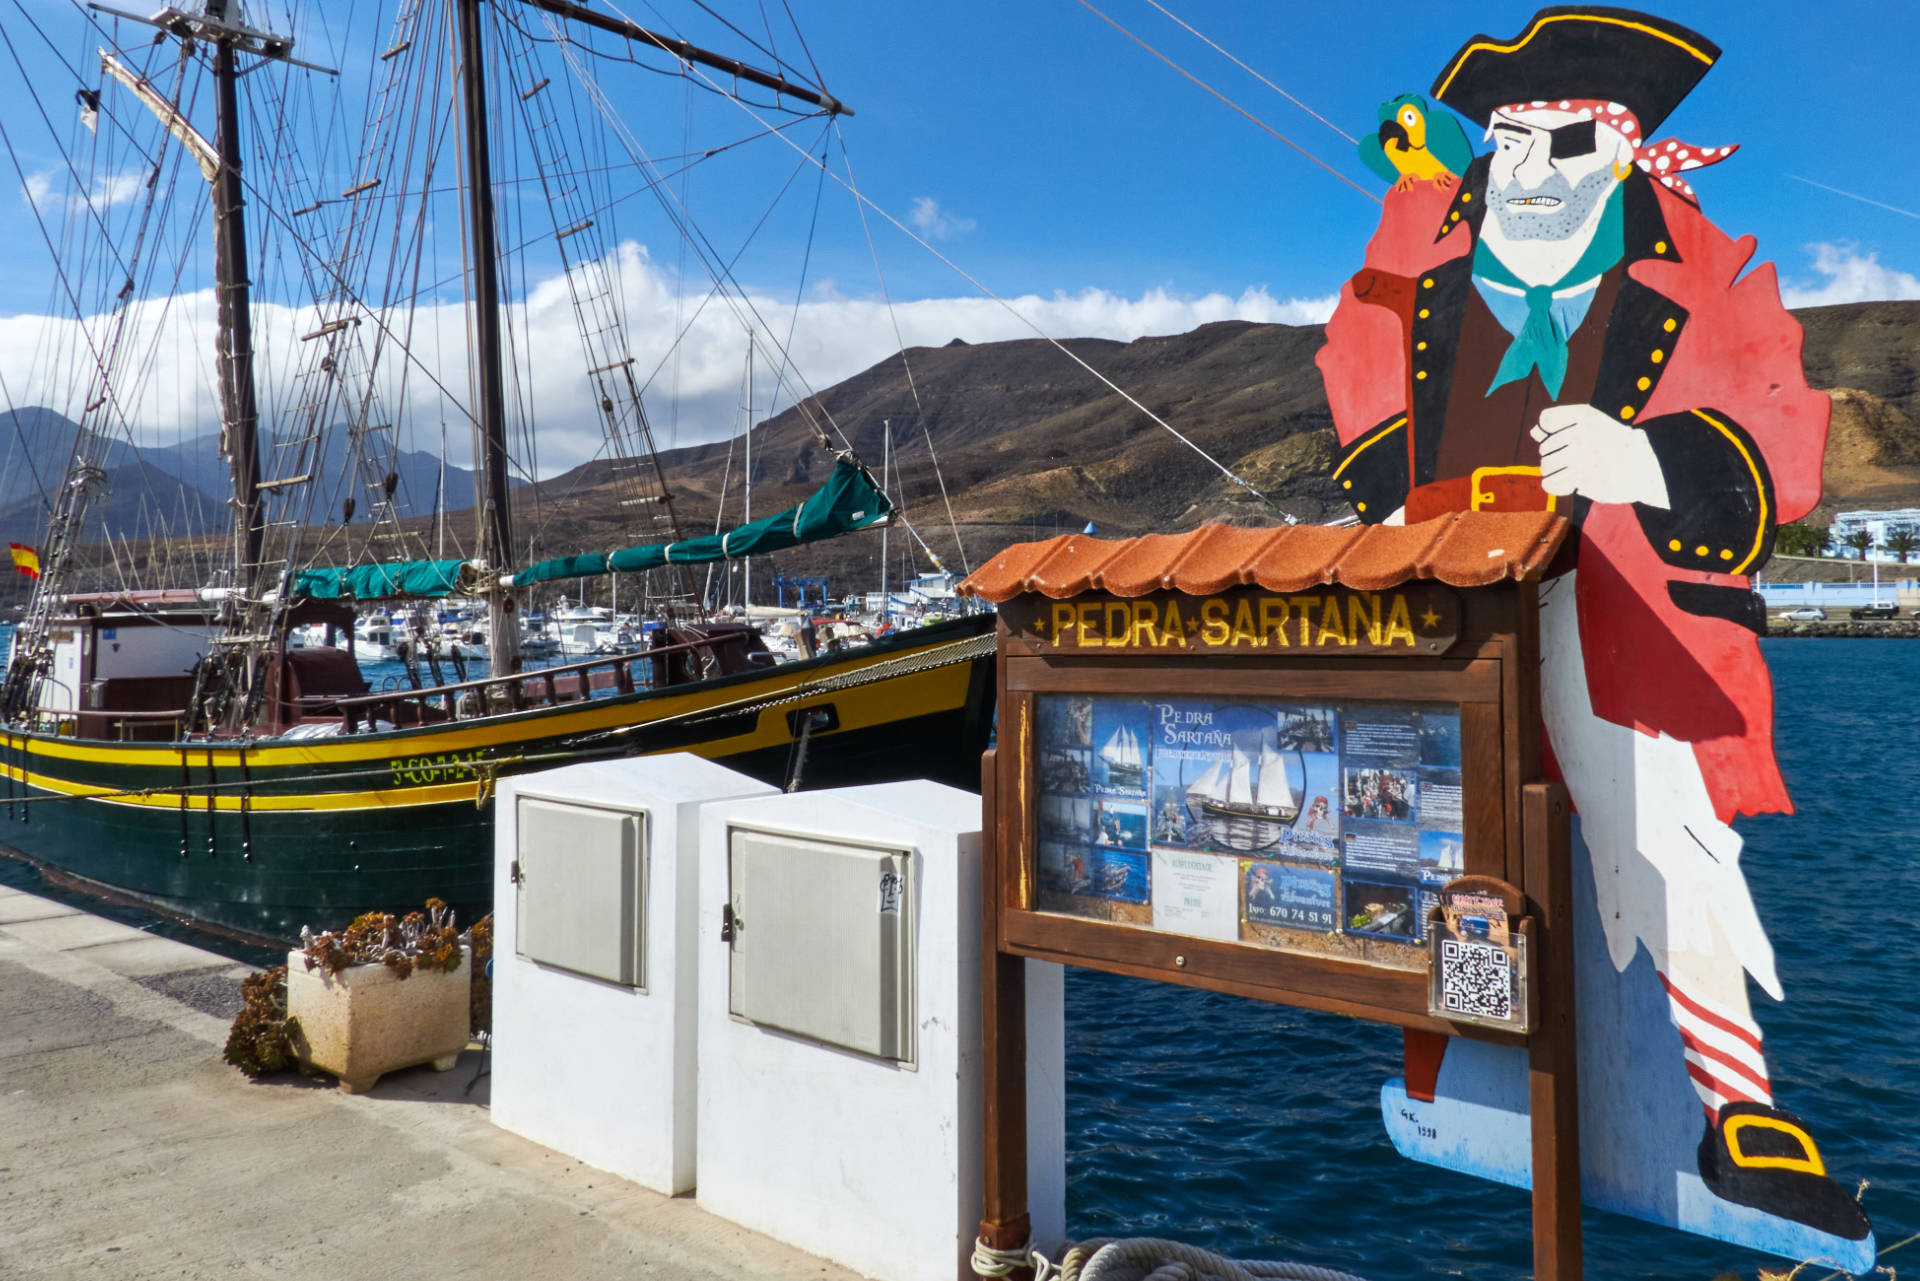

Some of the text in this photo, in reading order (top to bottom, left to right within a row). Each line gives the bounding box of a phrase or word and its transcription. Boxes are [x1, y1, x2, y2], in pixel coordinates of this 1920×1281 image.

[1052, 592, 1416, 647] PEDRA SARTAÑA
[1270, 906, 1288, 918] 670
[1291, 908, 1305, 921] 74
[1308, 911, 1318, 922] 51
[1322, 913, 1333, 925] 91
